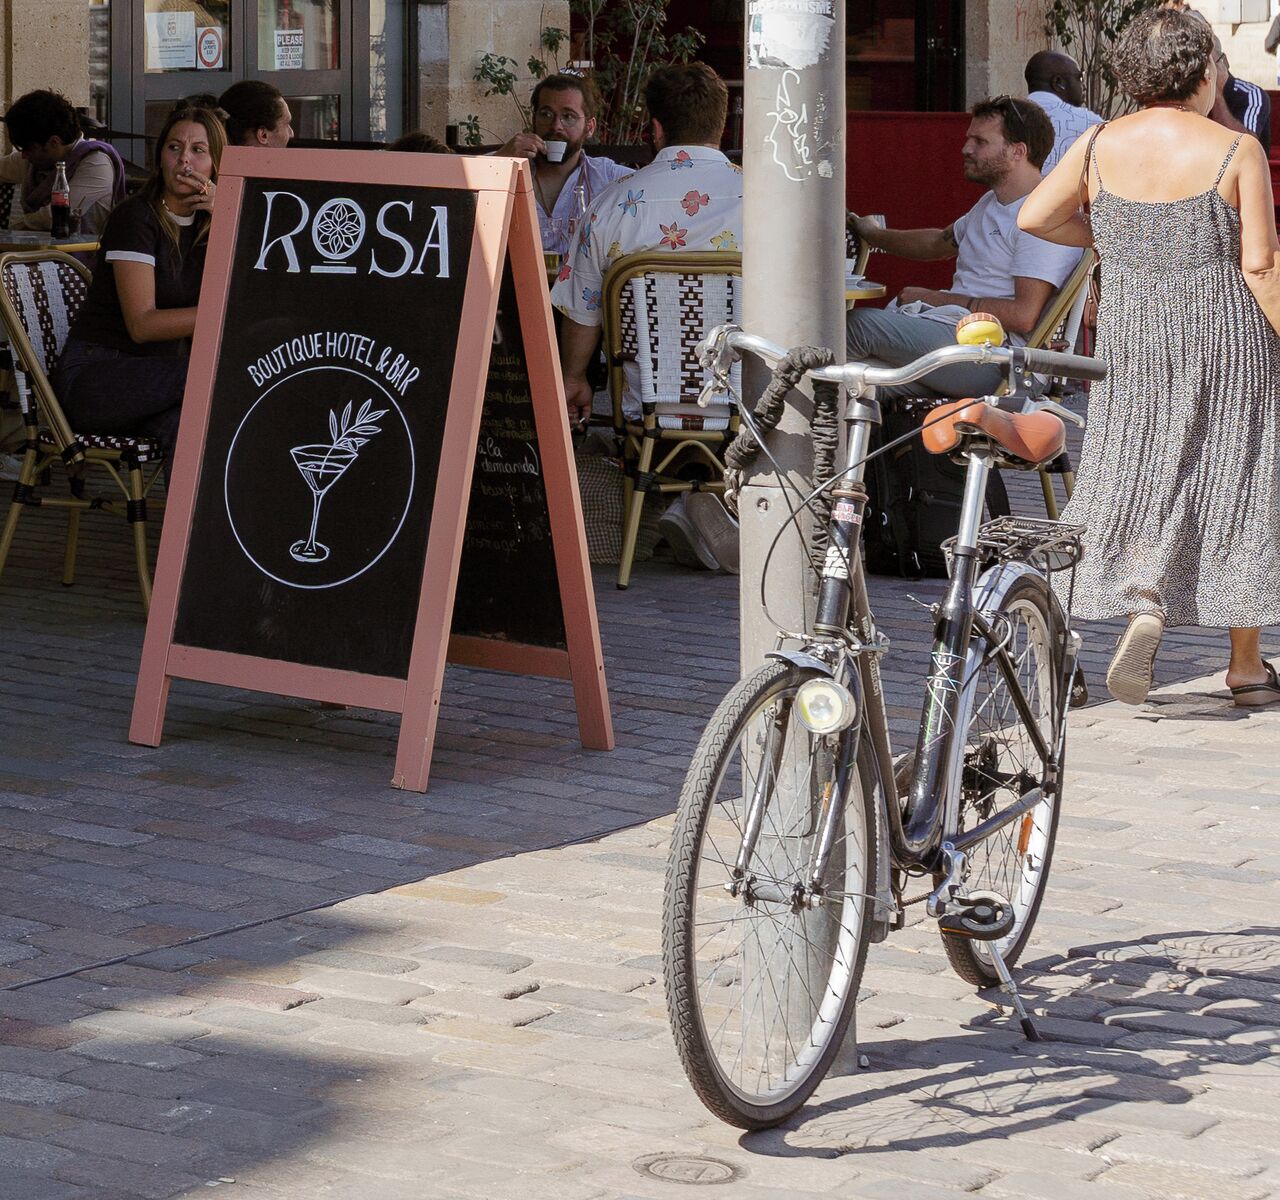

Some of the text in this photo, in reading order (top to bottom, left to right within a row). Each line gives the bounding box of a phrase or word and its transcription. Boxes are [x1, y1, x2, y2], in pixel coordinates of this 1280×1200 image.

[277, 35, 303, 46] PLEASE
[253, 191, 450, 279] ROSA
[247, 331, 421, 396] BOUTIQUE HOTEL & BAR
[486, 436, 503, 458] la
